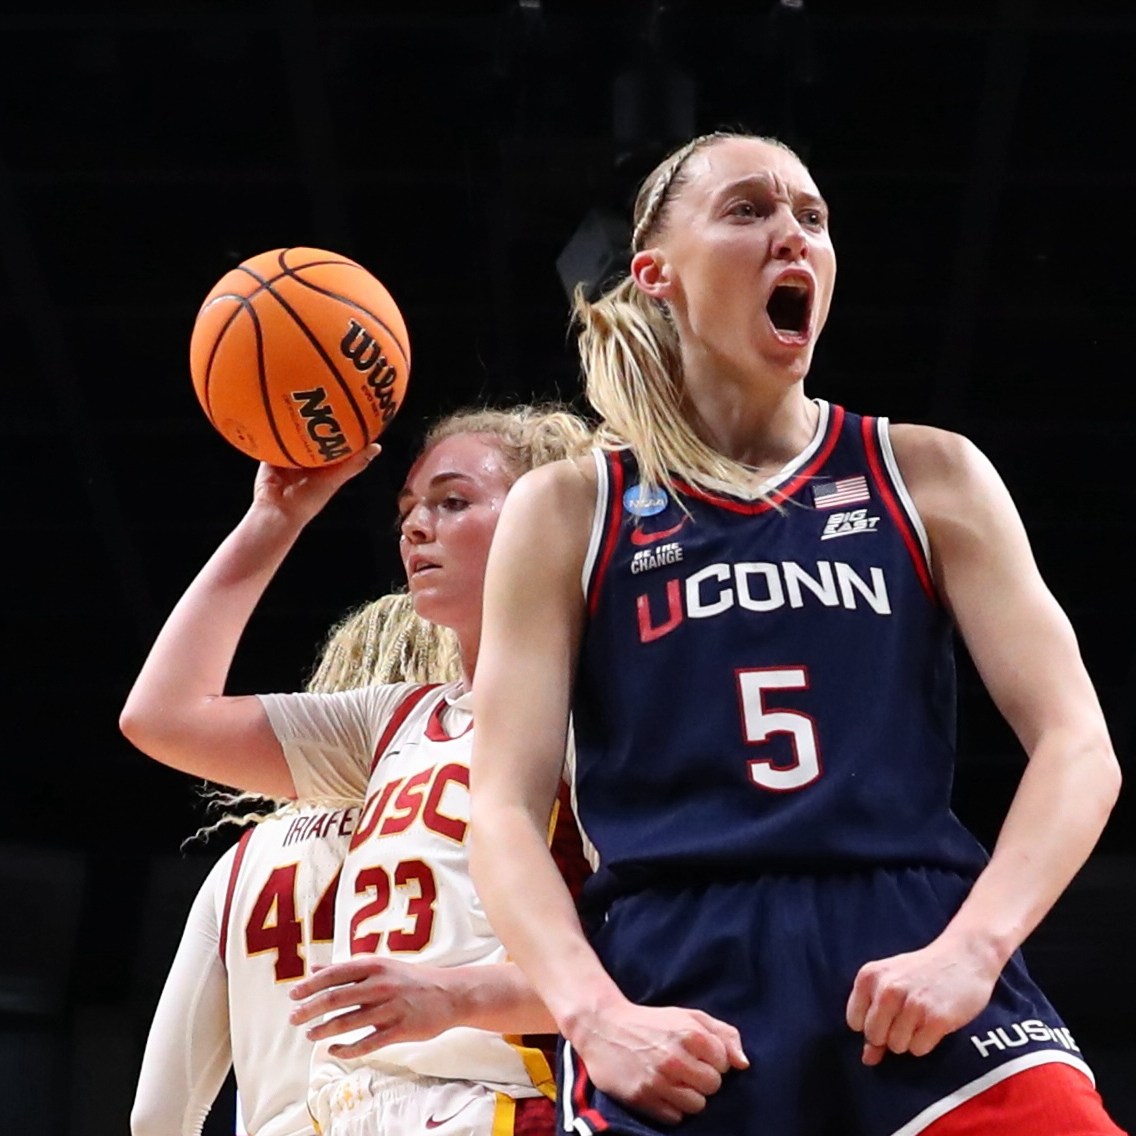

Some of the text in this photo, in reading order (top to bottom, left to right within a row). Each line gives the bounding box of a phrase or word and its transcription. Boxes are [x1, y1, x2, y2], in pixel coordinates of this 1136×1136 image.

[823, 516, 880, 534] EAST
[827, 508, 868, 525] BIG
[631, 547, 683, 575] CHANGE
[636, 560, 892, 644] UCONN
[734, 665, 825, 793] 5
[282, 806, 362, 847] IRIAFE
[348, 762, 471, 854] USC
[350, 858, 439, 957] 23
